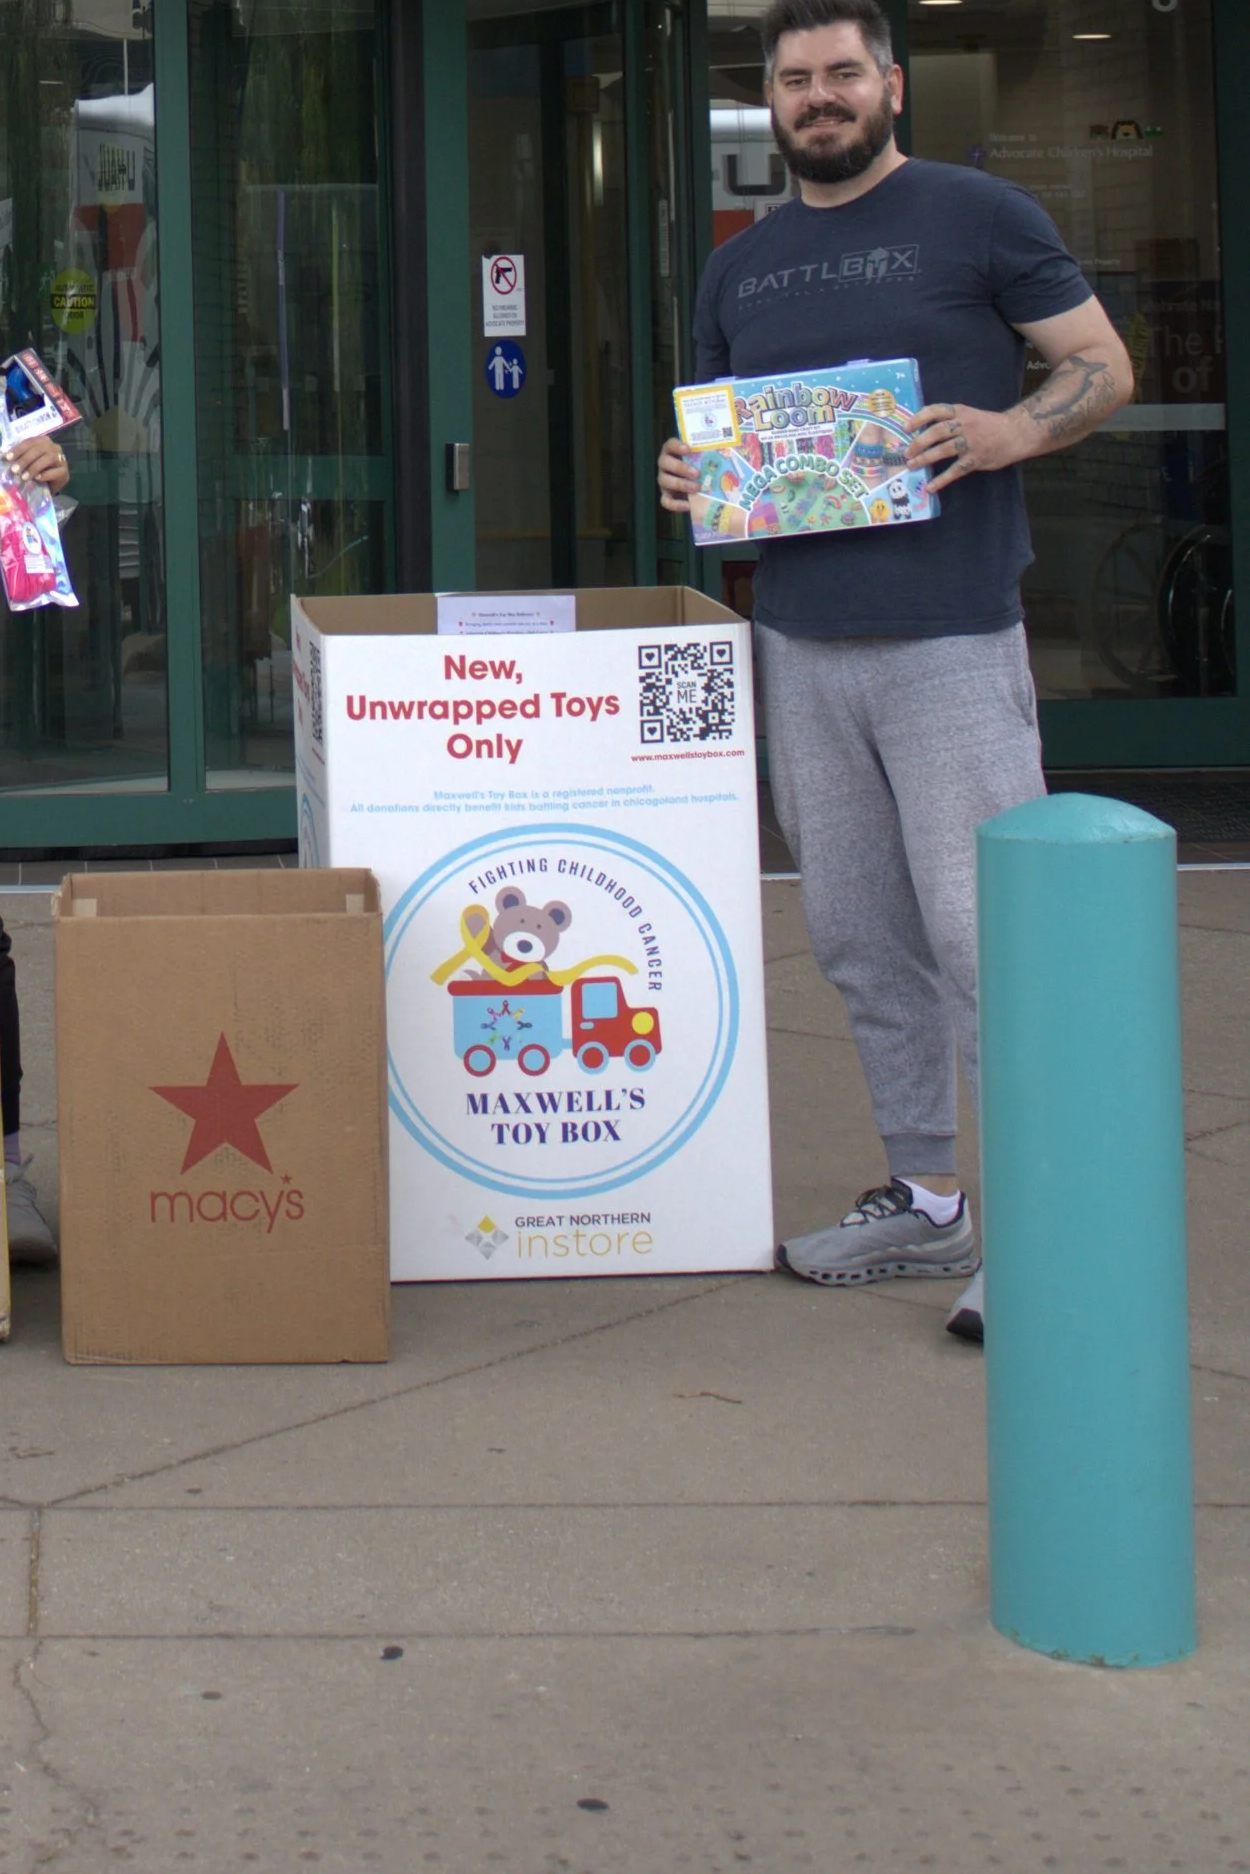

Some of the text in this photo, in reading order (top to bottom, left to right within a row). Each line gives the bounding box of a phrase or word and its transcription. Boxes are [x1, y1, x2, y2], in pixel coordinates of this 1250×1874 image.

[989, 146, 1044, 159] Advocate
[1106, 144, 1154, 162] Hospital
[53, 295, 96, 308] CAUTION
[734, 381, 858, 426] Rainbow
[752, 405, 837, 432] Loom
[739, 454, 869, 511] MEGA COMBO SET
[443, 654, 523, 685] New,
[676, 680, 697, 689] SCAN
[677, 689, 697, 704] ME
[346, 692, 620, 726] Unwrapped Toys
[446, 733, 524, 765] Only
[366, 803, 420, 813] donations
[422, 803, 461, 814] directly
[464, 802, 501, 812] benefit
[504, 802, 526, 811] kids
[529, 800, 570, 812] battling
[572, 799, 608, 809] cancer
[611, 798, 620, 807] in
[433, 790, 485, 800] Maxwell's
[488, 790, 505, 801] Toy
[508, 790, 528, 799] Box
[531, 789, 539, 799] is
[542, 791, 549, 799] a
[552, 787, 604, 799] registered
[468, 857, 663, 991] FIGHTING CHILDHOOD CANCER
[465, 1087, 646, 1116] MAXWELL'S
[490, 1120, 622, 1145] TOY BOX
[514, 1212, 651, 1228] GREAT NORTHERN
[517, 1228, 654, 1258] instore
